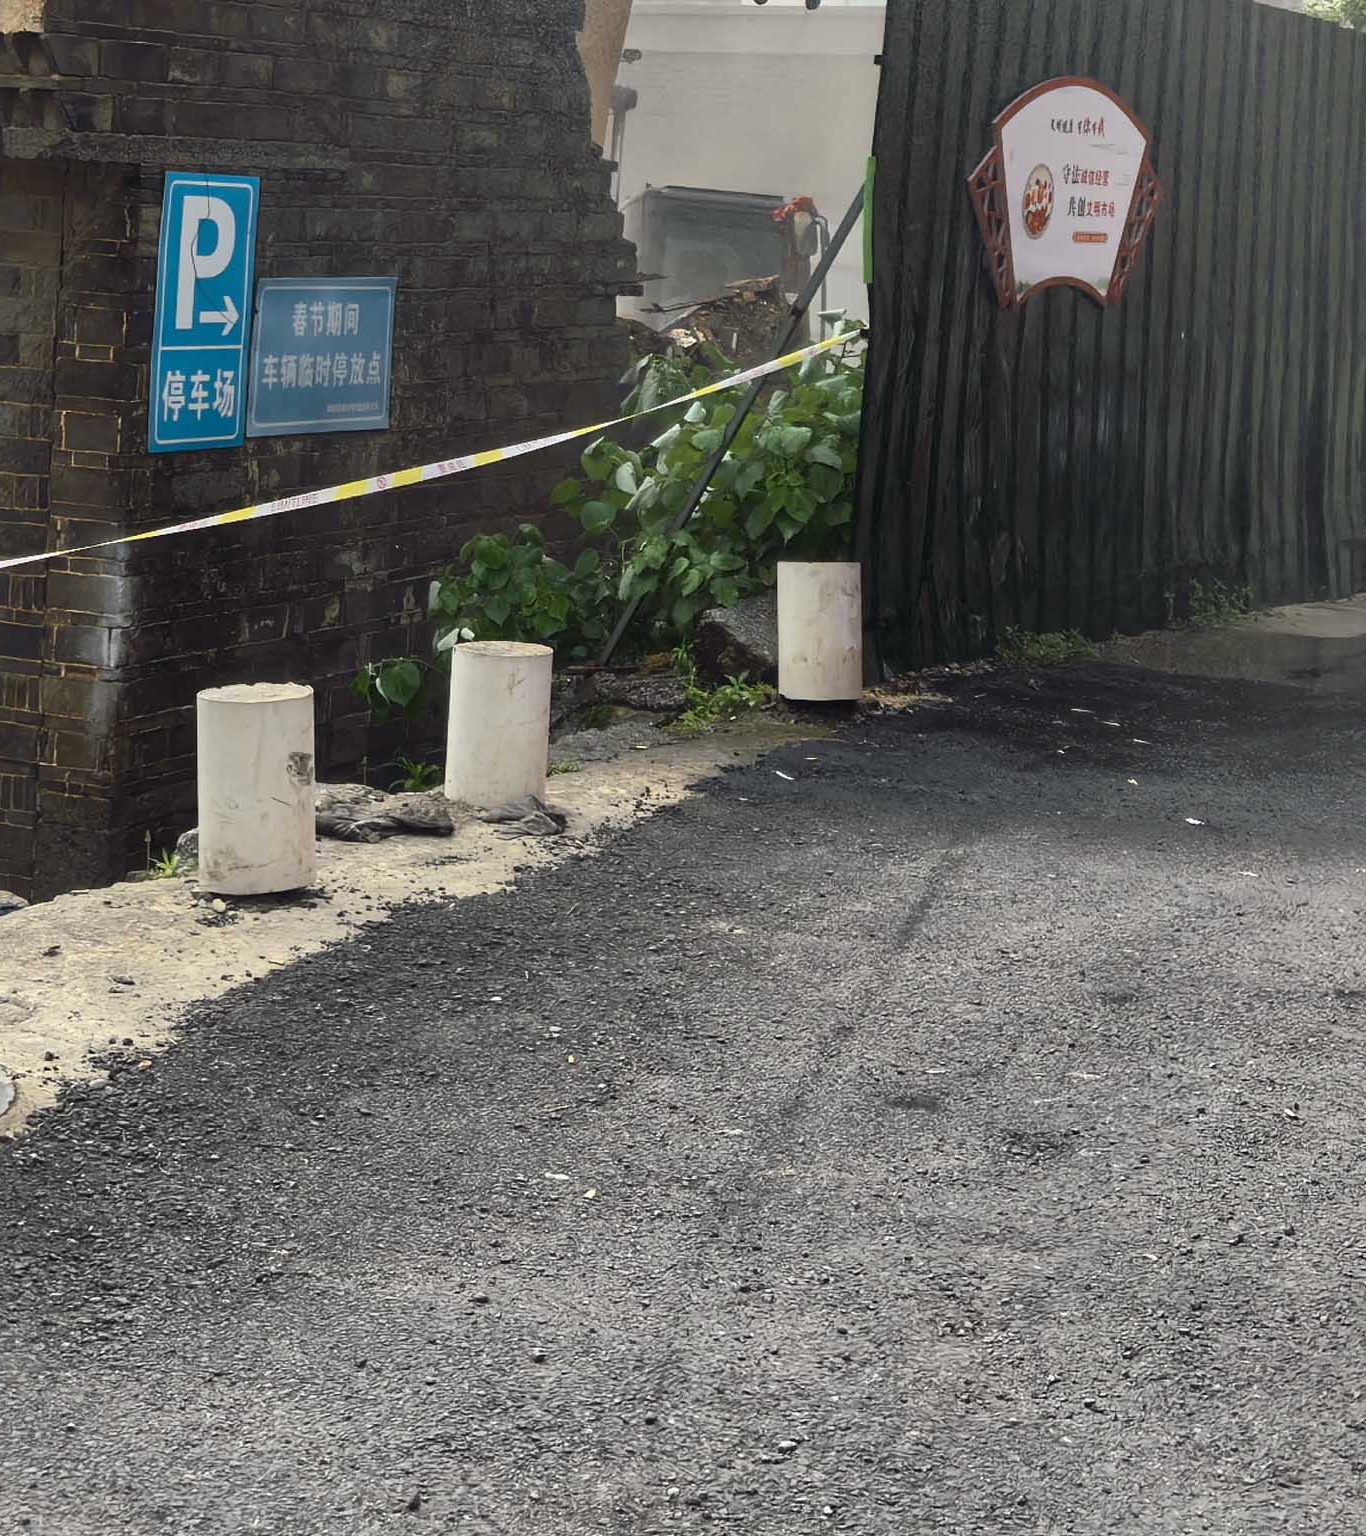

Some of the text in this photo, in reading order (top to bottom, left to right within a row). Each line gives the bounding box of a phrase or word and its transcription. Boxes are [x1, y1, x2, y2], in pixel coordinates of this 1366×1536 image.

[175, 195, 236, 330] P
[292, 300, 360, 337] 春节期间
[261, 349, 381, 391] 车辆临时停放点
[162, 368, 236, 422] 停车场
